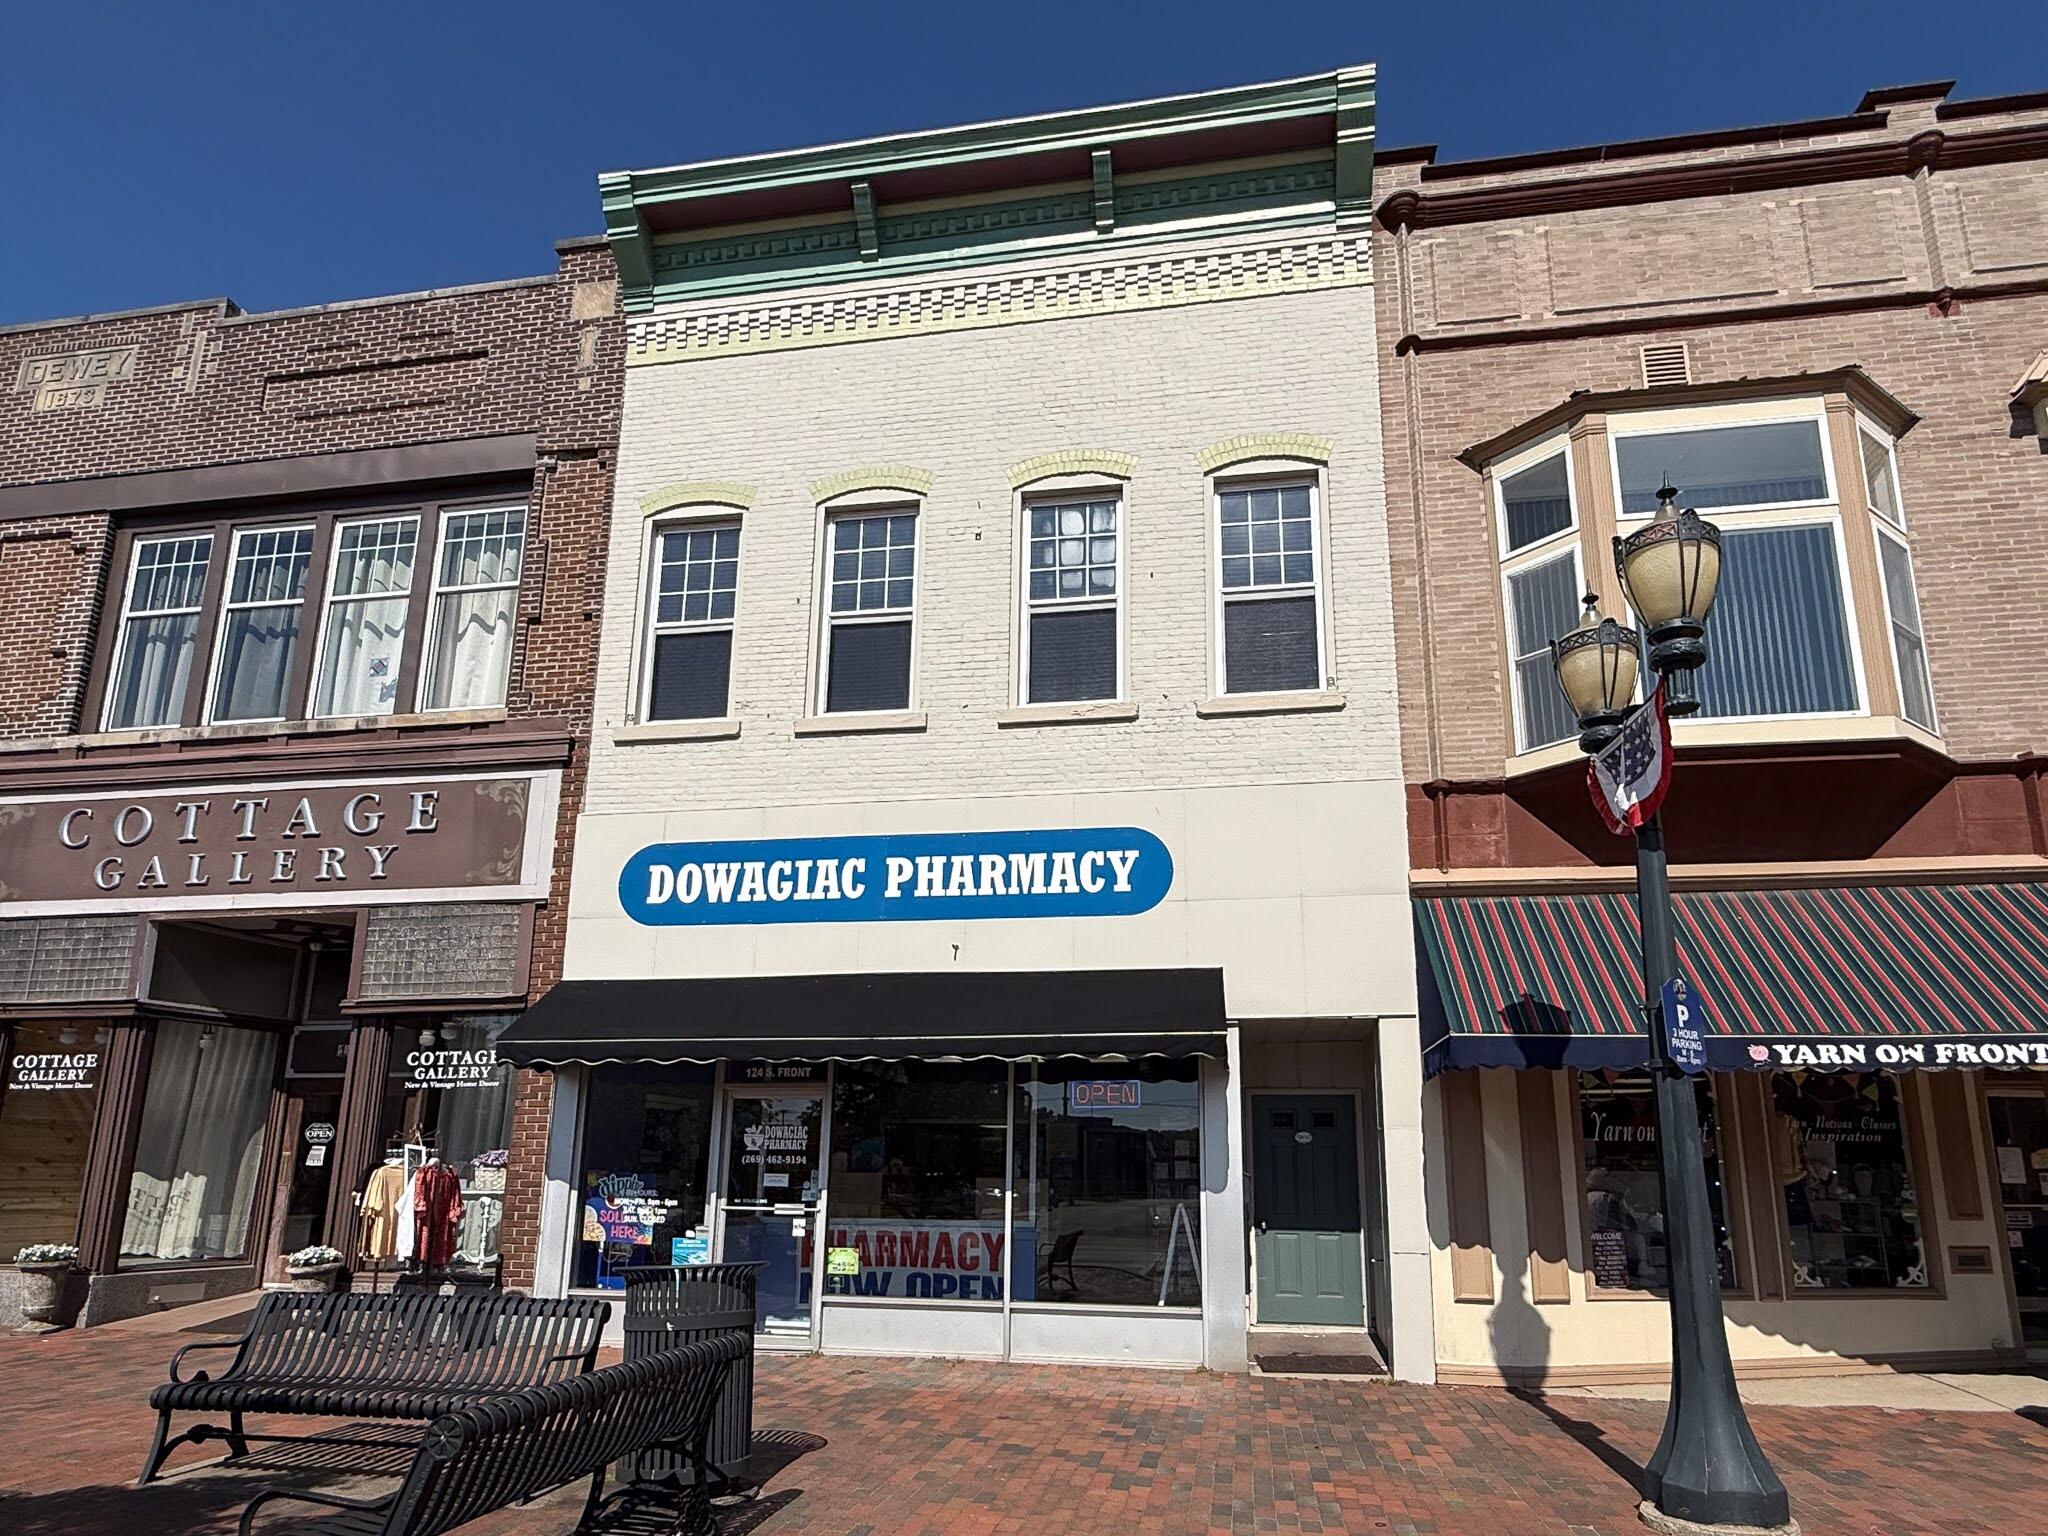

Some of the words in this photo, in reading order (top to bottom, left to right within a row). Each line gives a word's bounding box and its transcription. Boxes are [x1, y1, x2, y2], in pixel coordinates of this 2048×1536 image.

[26, 351, 132, 385] DEWEY
[57, 790, 440, 850] COTTAGE
[93, 845, 398, 891] GALLERY
[646, 857, 867, 904] DOWAGIAC
[884, 850, 1139, 898] PHARMACY
[1676, 1004, 1689, 1027] P
[1678, 1029, 1699, 1041] HOUR
[1671, 1037, 1703, 1051] PARKING
[1772, 1044, 1866, 1064] YARN
[1875, 1044, 1925, 1064] ON
[1934, 1043, 2048, 1064] FRONT
[12, 1054, 98, 1068] COTTAGE
[18, 1069, 87, 1081] GALLERY
[414, 1066, 492, 1079] GALLERY
[745, 1067, 763, 1077] 124
[777, 1067, 812, 1077] FRONT
[1076, 1084, 1135, 1104] OPEN
[1591, 1111, 1632, 1142] Yarn
[1861, 1116, 1897, 1130] Classes
[306, 1130, 333, 1138] OPEN
[764, 1125, 809, 1139] DOWAGIAC
[1805, 1128, 1882, 1144] Inspiration
[763, 1139, 808, 1151] PHARMACY
[741, 1155, 764, 1165] (269)
[766, 1155, 807, 1165] 462-9194
[905, 1271, 1005, 1300] OPEN
